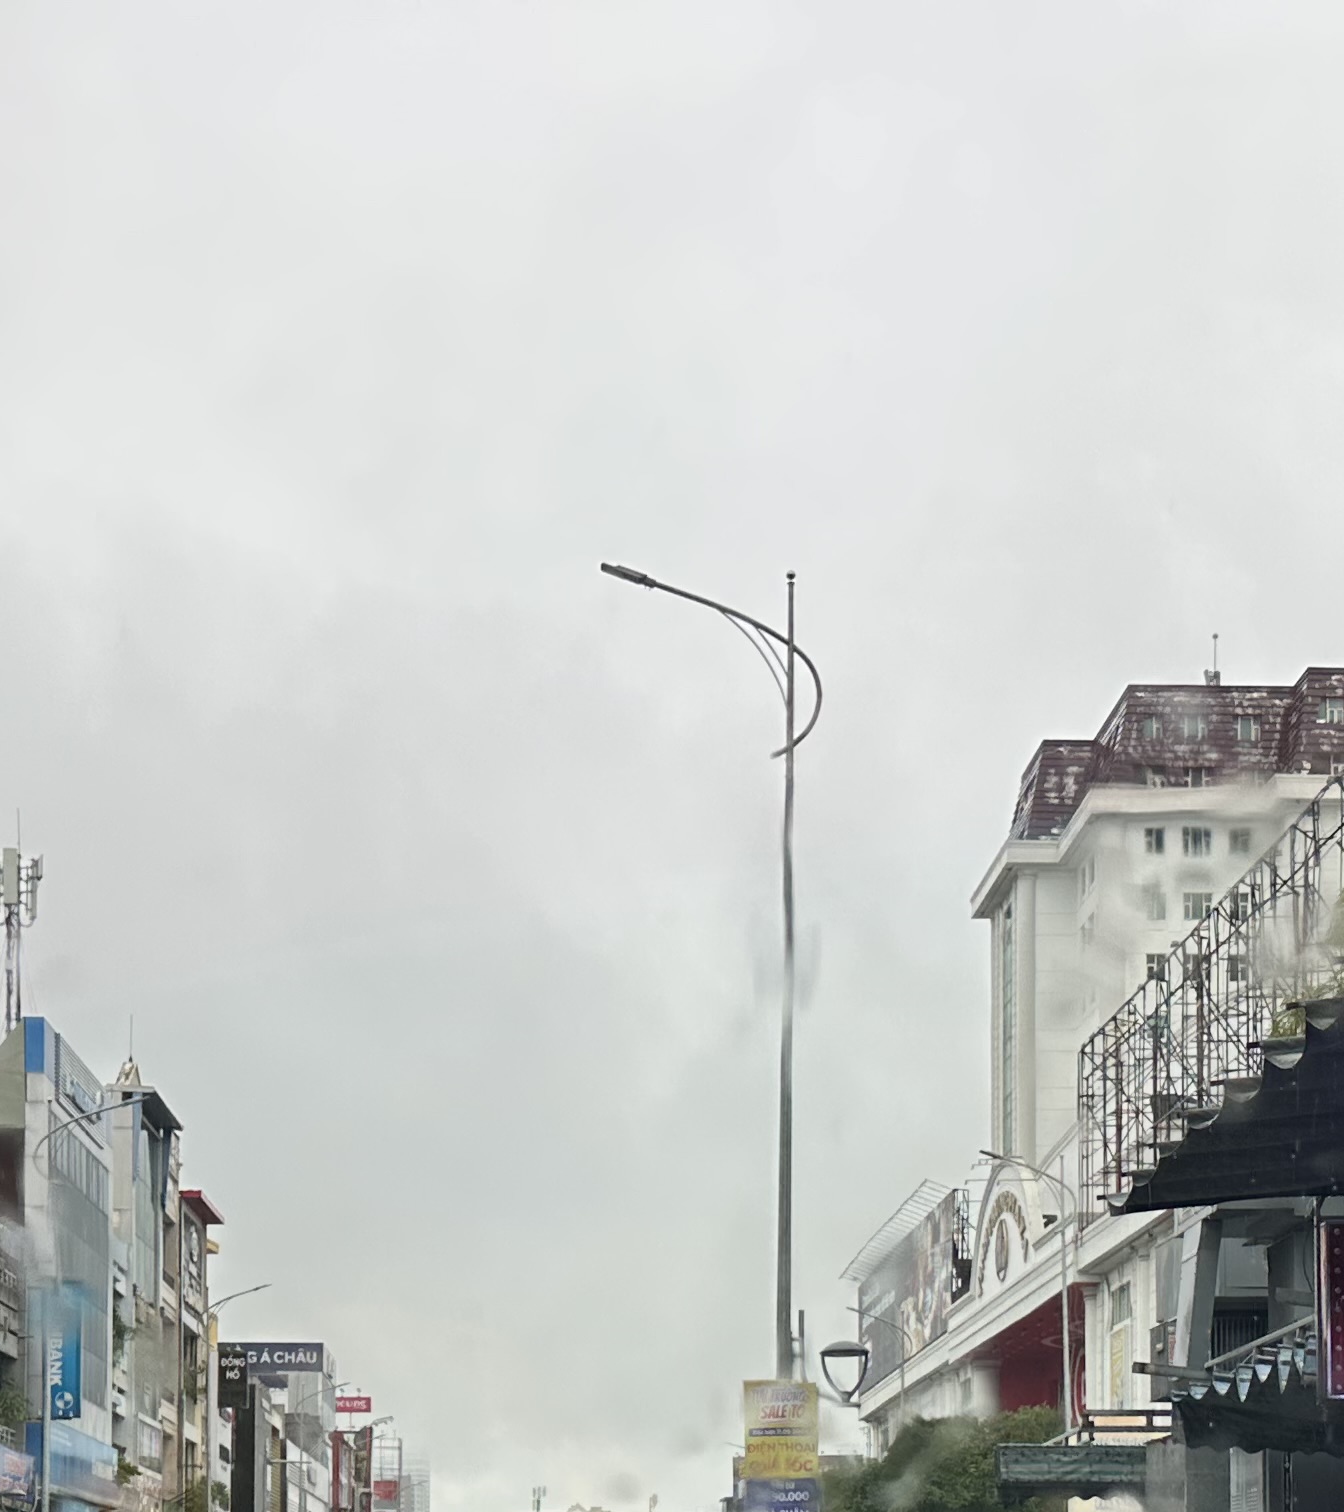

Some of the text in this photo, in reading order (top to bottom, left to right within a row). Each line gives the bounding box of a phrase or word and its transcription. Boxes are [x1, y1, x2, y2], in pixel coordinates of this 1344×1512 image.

[260, 1348, 272, 1364] Á
[273, 1347, 318, 1365] CHÂU
[760, 1403, 787, 1420] SALE
